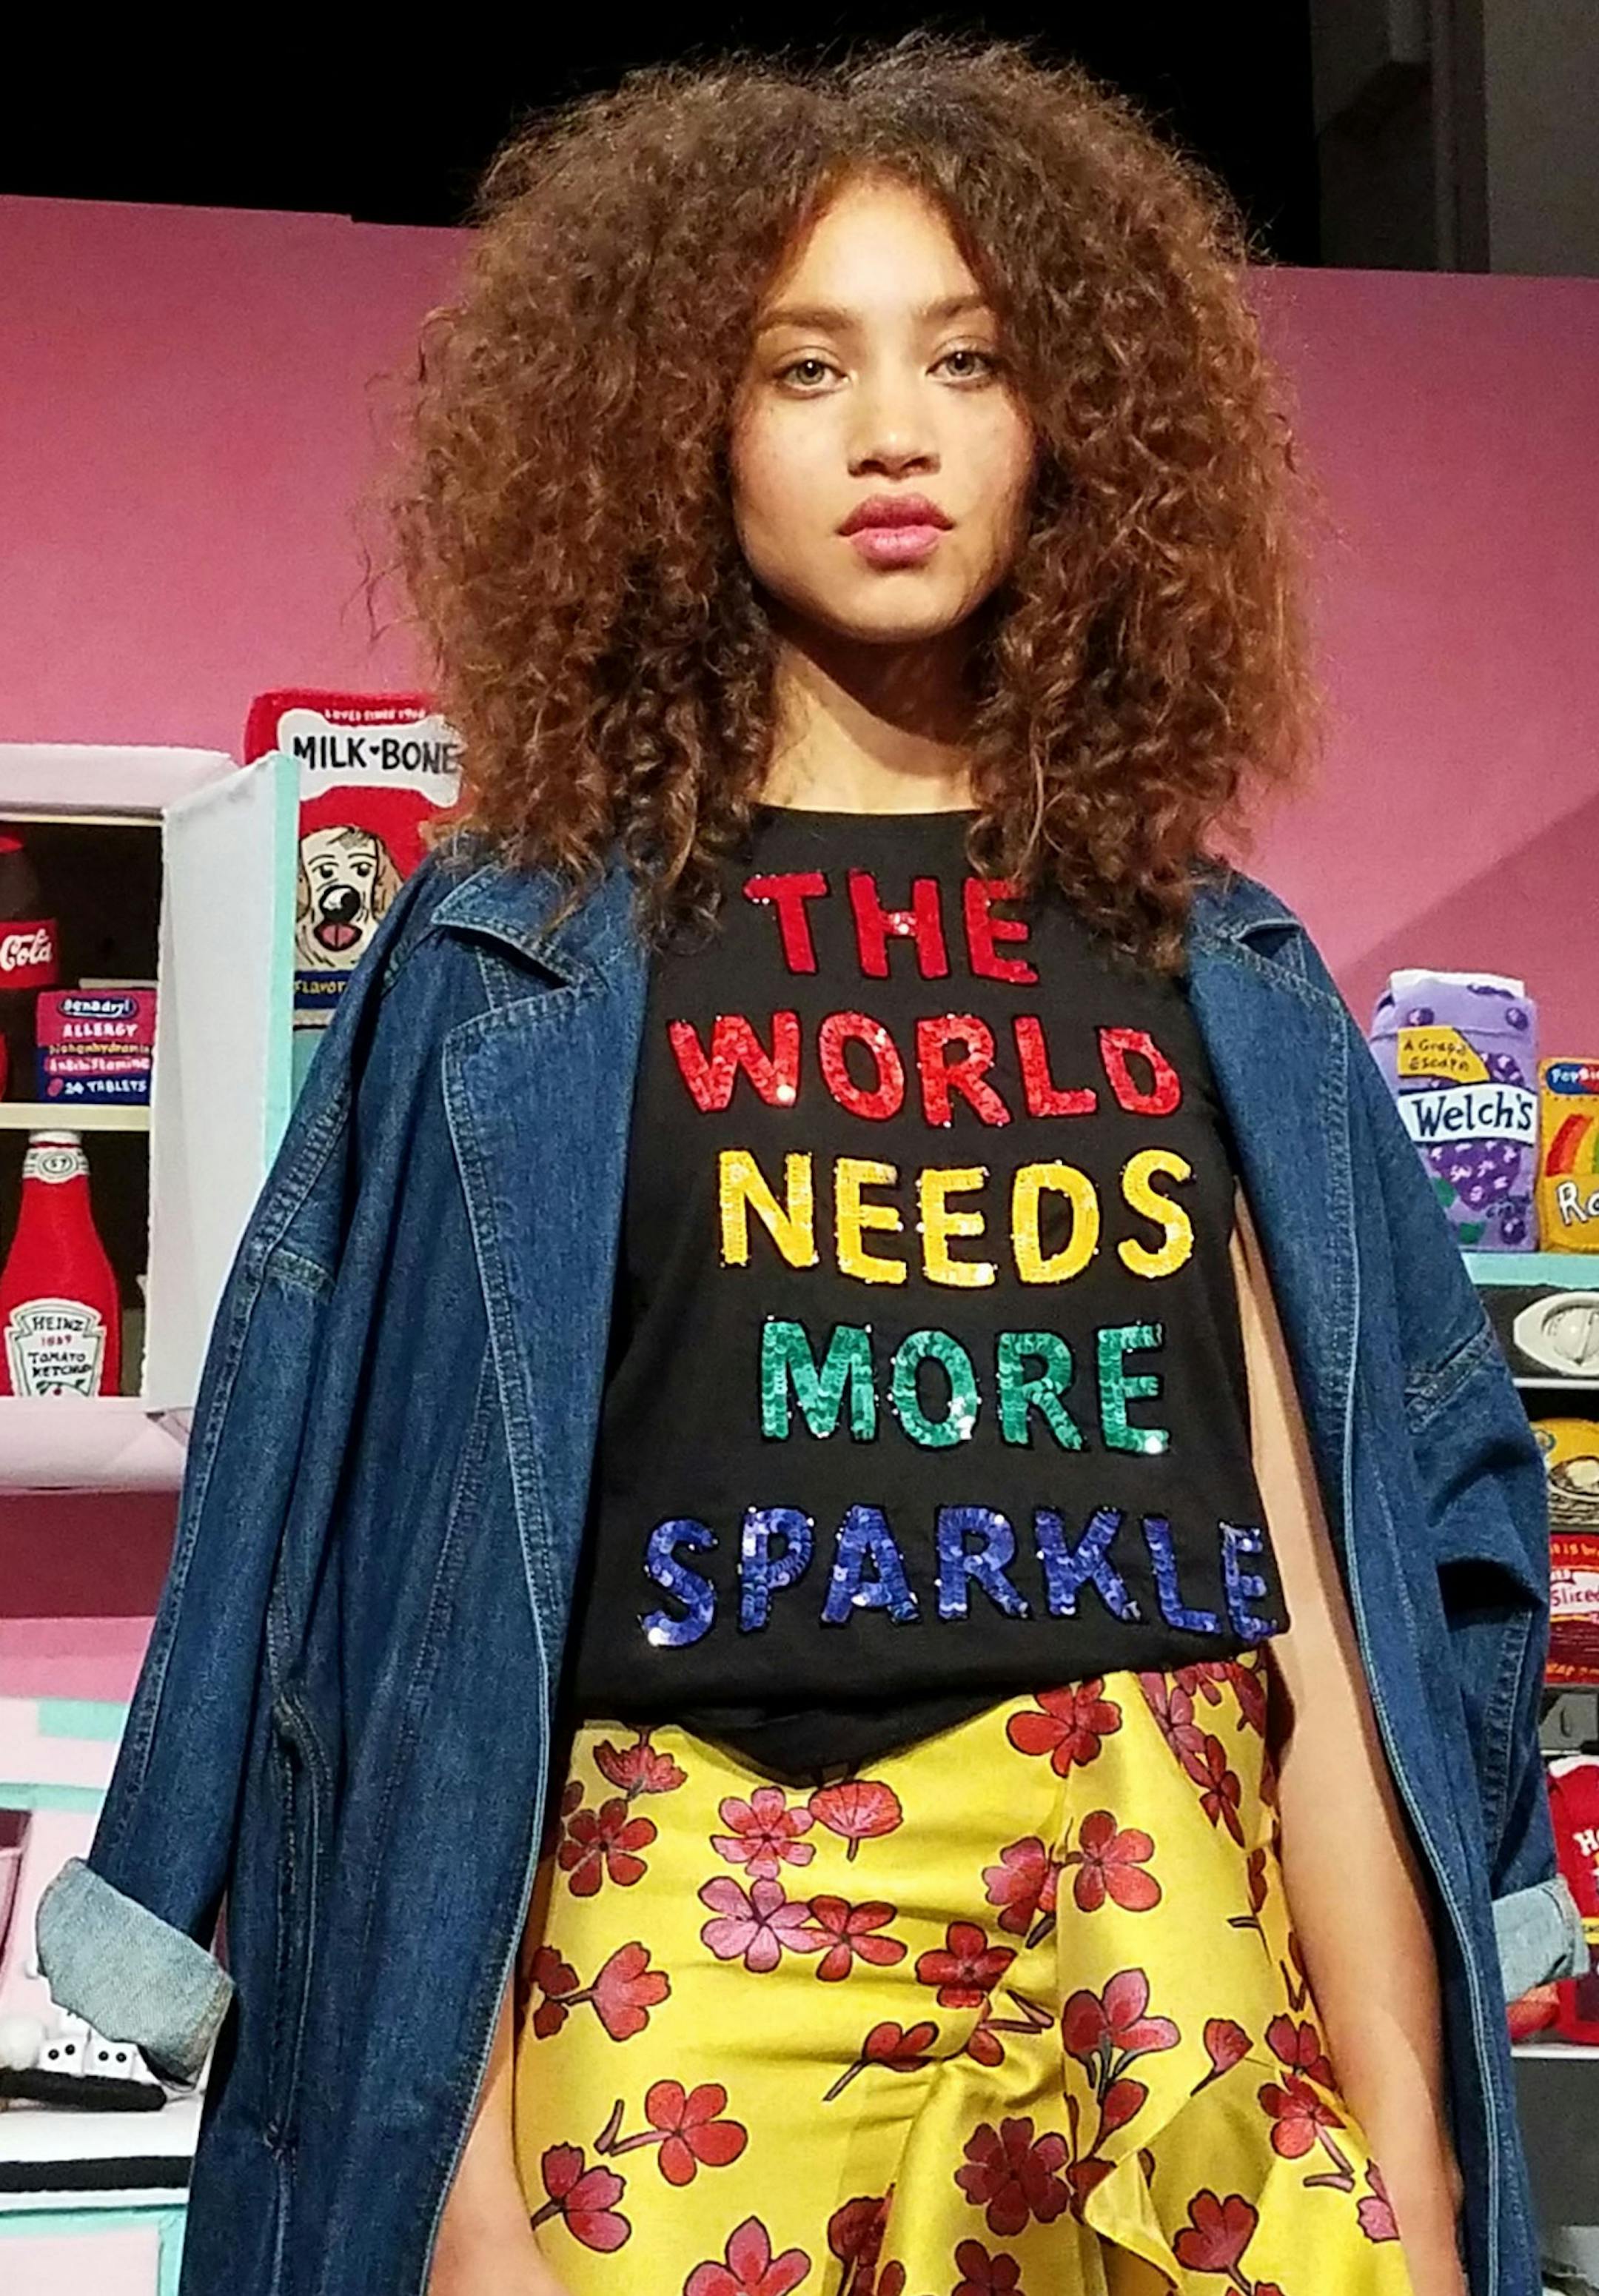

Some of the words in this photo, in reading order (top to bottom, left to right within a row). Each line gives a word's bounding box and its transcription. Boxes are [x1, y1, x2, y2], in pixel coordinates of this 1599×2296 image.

[293, 735, 366, 770] MILK
[382, 737, 460, 774] BONE
[742, 868, 1038, 985] THE
[62, 1021, 138, 1037] ALLERGY
[667, 1010, 1184, 1128] WORLD
[1411, 1091, 1533, 1137] Welch's
[717, 1148, 1196, 1288] NEEDS
[28, 1351, 86, 1364] TOMATO
[33, 1316, 84, 1331] HEINZ
[759, 1316, 1170, 1456] MORE
[637, 1505, 1285, 1650] SPARKLE
